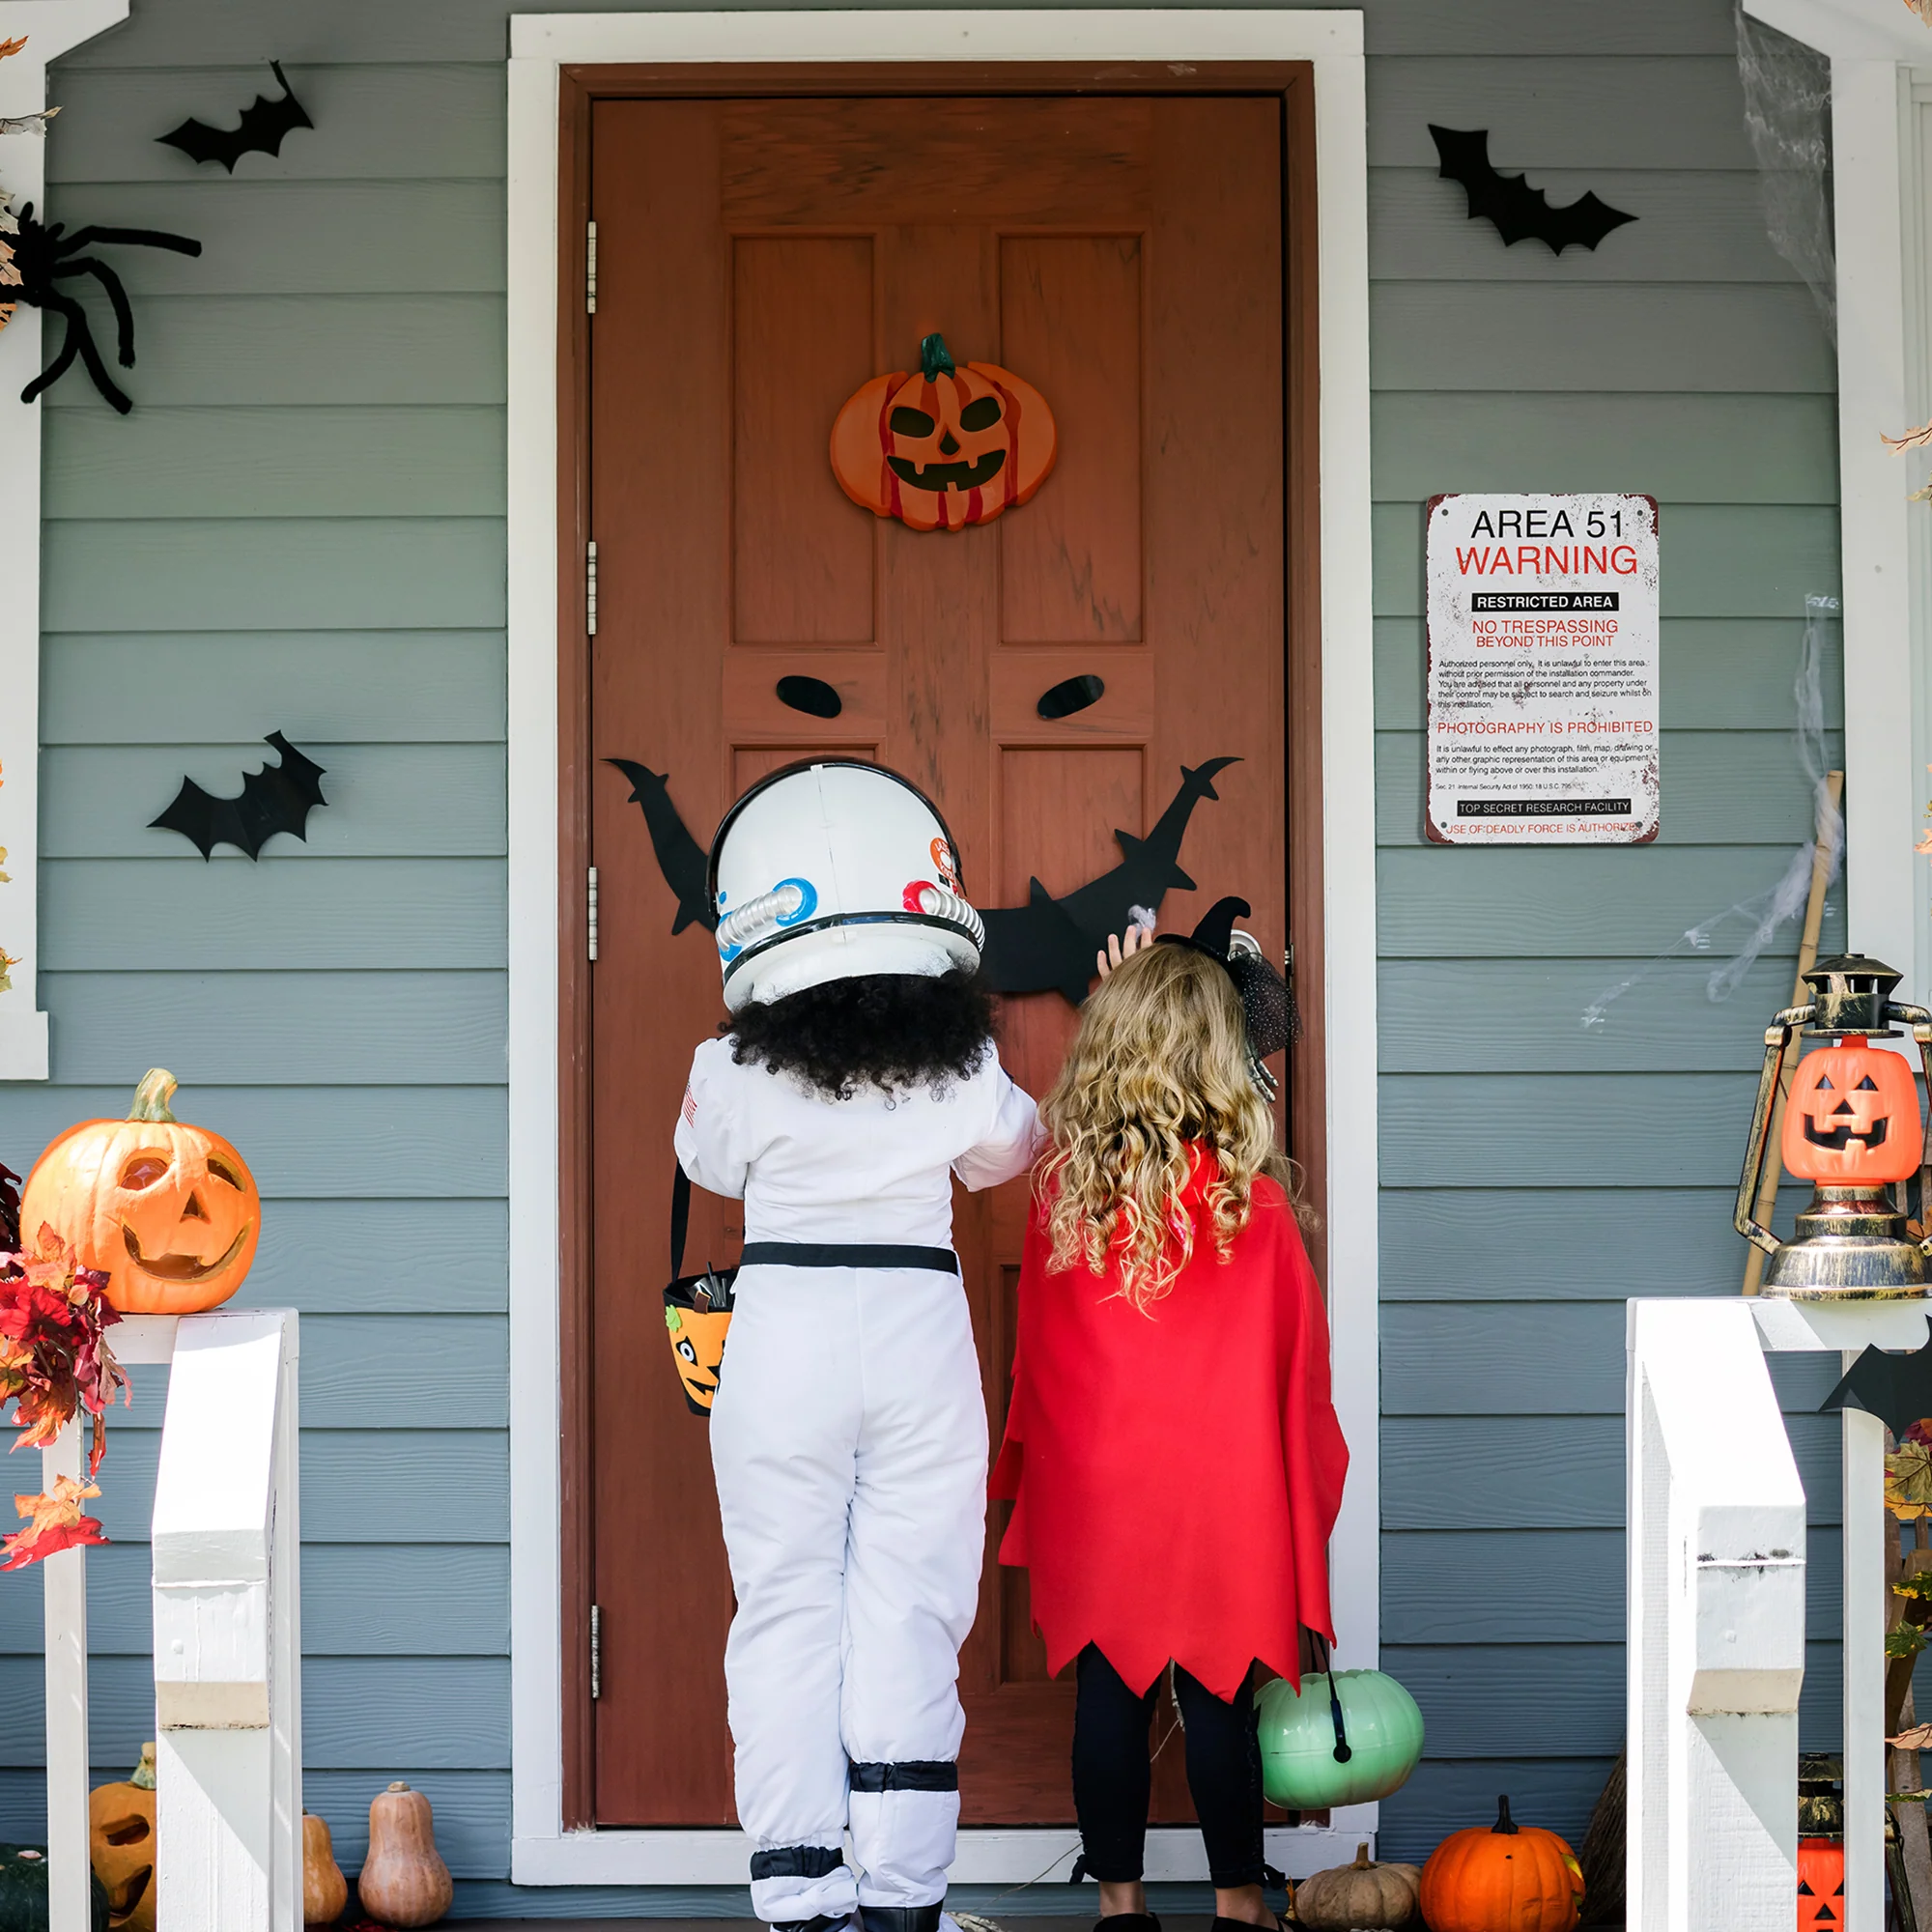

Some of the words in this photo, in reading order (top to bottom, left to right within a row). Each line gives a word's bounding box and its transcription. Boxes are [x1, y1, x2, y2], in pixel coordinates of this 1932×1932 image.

[1470, 510, 1575, 538] AREA
[1586, 511, 1622, 538] 51
[1456, 546, 1637, 575] WARNING
[1477, 596, 1569, 609] RESTRICTED
[1573, 596, 1613, 608] AREA
[1472, 620, 1497, 634] NO
[1501, 619, 1618, 634] TRESPASSING
[1476, 636, 1534, 647] BEYOND
[1536, 636, 1568, 647] THIS
[1573, 636, 1614, 647] POINT
[1479, 660, 1516, 669] personnel
[1524, 680, 1560, 689] personnel
[1594, 680, 1624, 689] property
[1511, 691, 1538, 699] subject
[1437, 723, 1546, 734] PHOTOGRAPHY
[1549, 722, 1563, 733] IS
[1568, 721, 1653, 733] PROHIBITED
[1614, 744, 1643, 753] drawing
[1502, 755, 1555, 764] representation
[1609, 754, 1649, 763] equipment
[1468, 766, 1488, 775] flying
[1460, 804, 1480, 813] TOP
[1483, 804, 1523, 813] SECRET
[1526, 803, 1582, 812] RESEARCH
[1584, 802, 1629, 811] FACILITY
[1446, 824, 1466, 834] USE
[1468, 824, 1484, 834] OF
[1486, 824, 1525, 834] DEADLY
[1527, 824, 1563, 834] FORCE
[1566, 823, 1576, 833] IS
